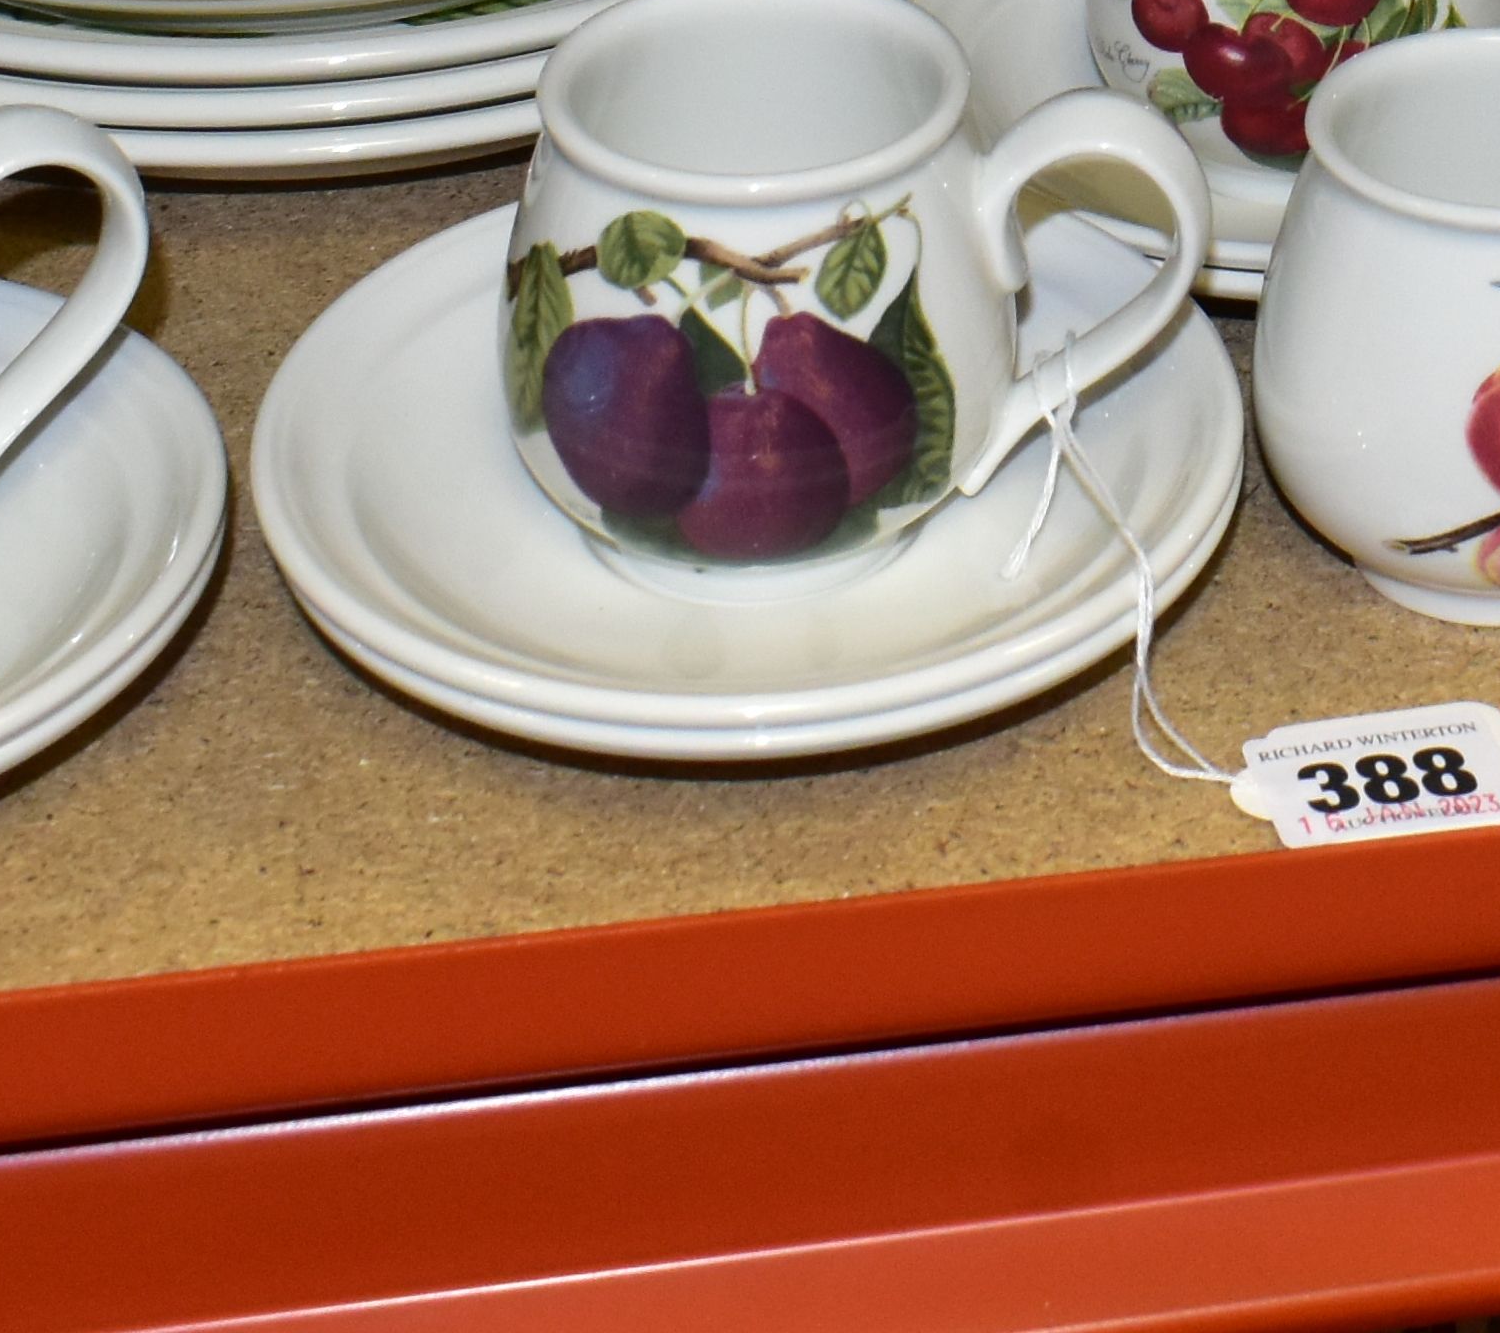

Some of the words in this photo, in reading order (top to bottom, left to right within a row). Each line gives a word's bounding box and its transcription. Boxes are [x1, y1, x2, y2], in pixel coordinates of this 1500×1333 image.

[1257, 738, 1353, 764] RICHARD
[1355, 721, 1478, 748] WINTERTON
[1297, 746, 1479, 815] 388
